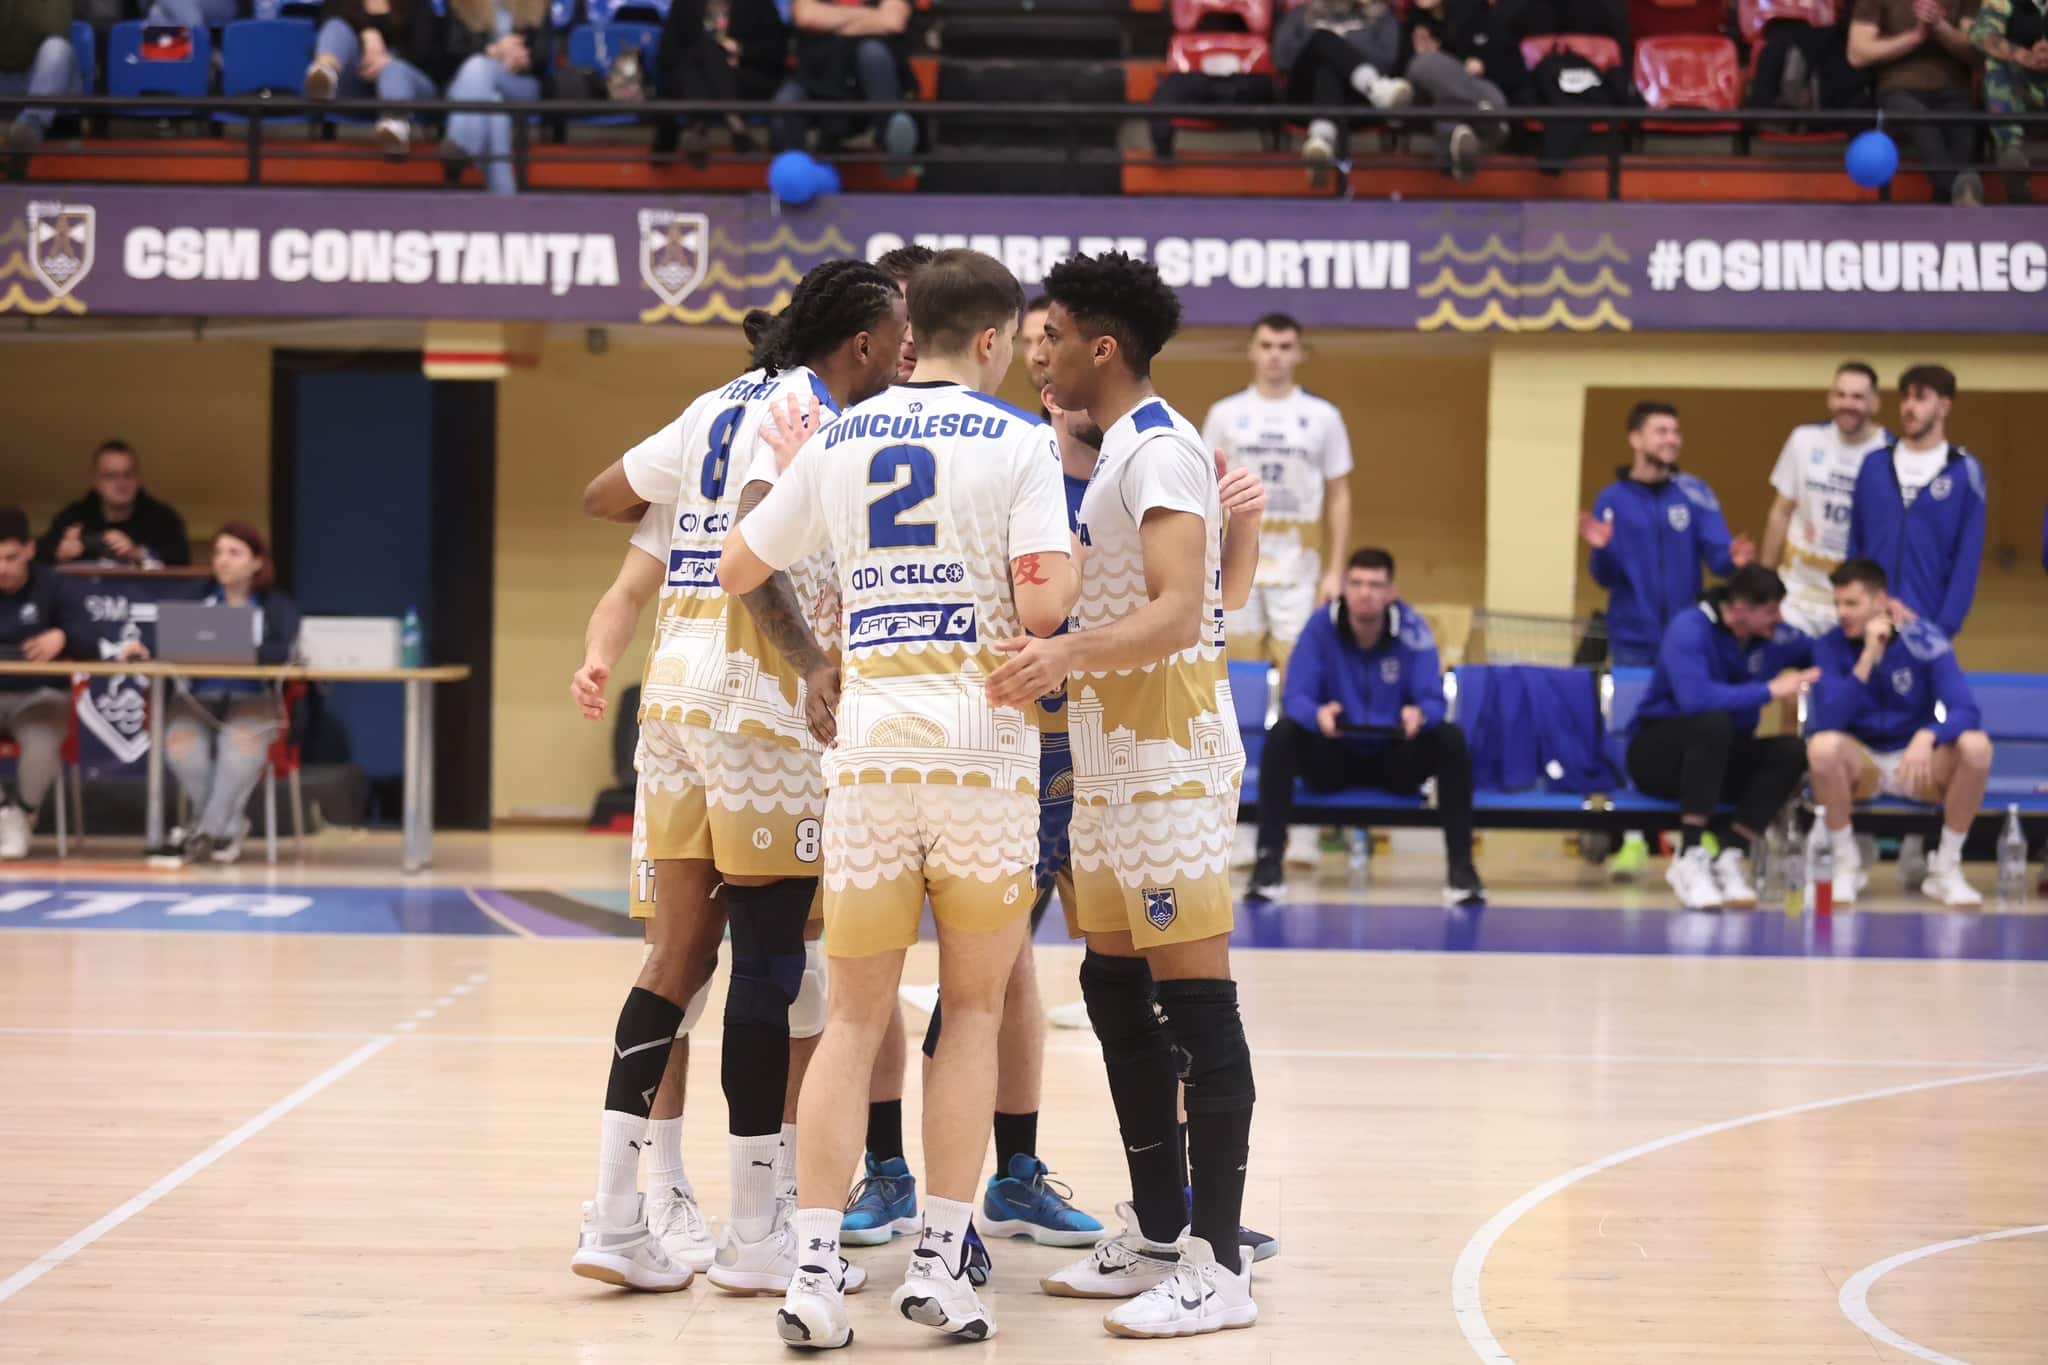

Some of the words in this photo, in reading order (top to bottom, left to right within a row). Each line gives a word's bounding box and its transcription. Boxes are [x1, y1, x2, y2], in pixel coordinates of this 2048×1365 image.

[124, 226, 260, 280] CSM
[1154, 237, 1411, 290] SPORTIVI
[701, 404, 746, 501] 8
[825, 413, 1009, 450] DINCULESCU
[868, 443, 938, 549] 2
[890, 563, 965, 585] CELCO
[859, 615, 937, 636] CATENA
[795, 818, 822, 863] 8
